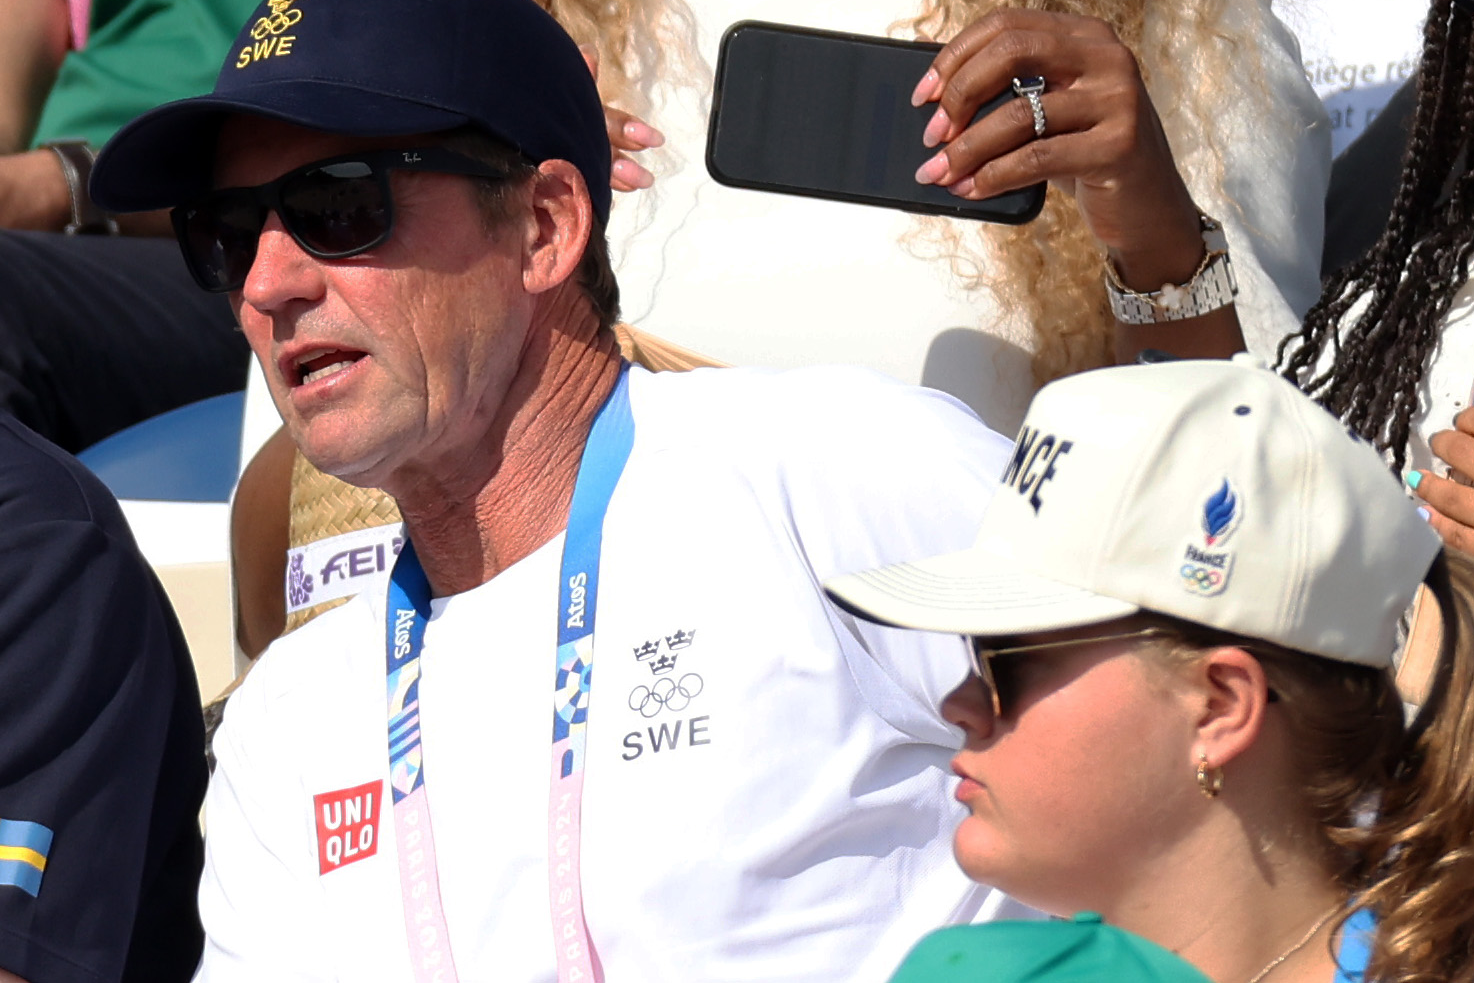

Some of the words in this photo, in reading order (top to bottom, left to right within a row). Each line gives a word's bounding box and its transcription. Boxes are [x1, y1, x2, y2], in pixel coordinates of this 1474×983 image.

[236, 34, 297, 69] SWE
[319, 542, 386, 586] FEI
[566, 571, 588, 629] Atos
[394, 608, 416, 660] Atos
[621, 714, 712, 762] SWE
[322, 792, 373, 830] UNI
[325, 823, 374, 866] QLO
[403, 808, 429, 899] PARIS
[558, 886, 584, 982] PARIS
